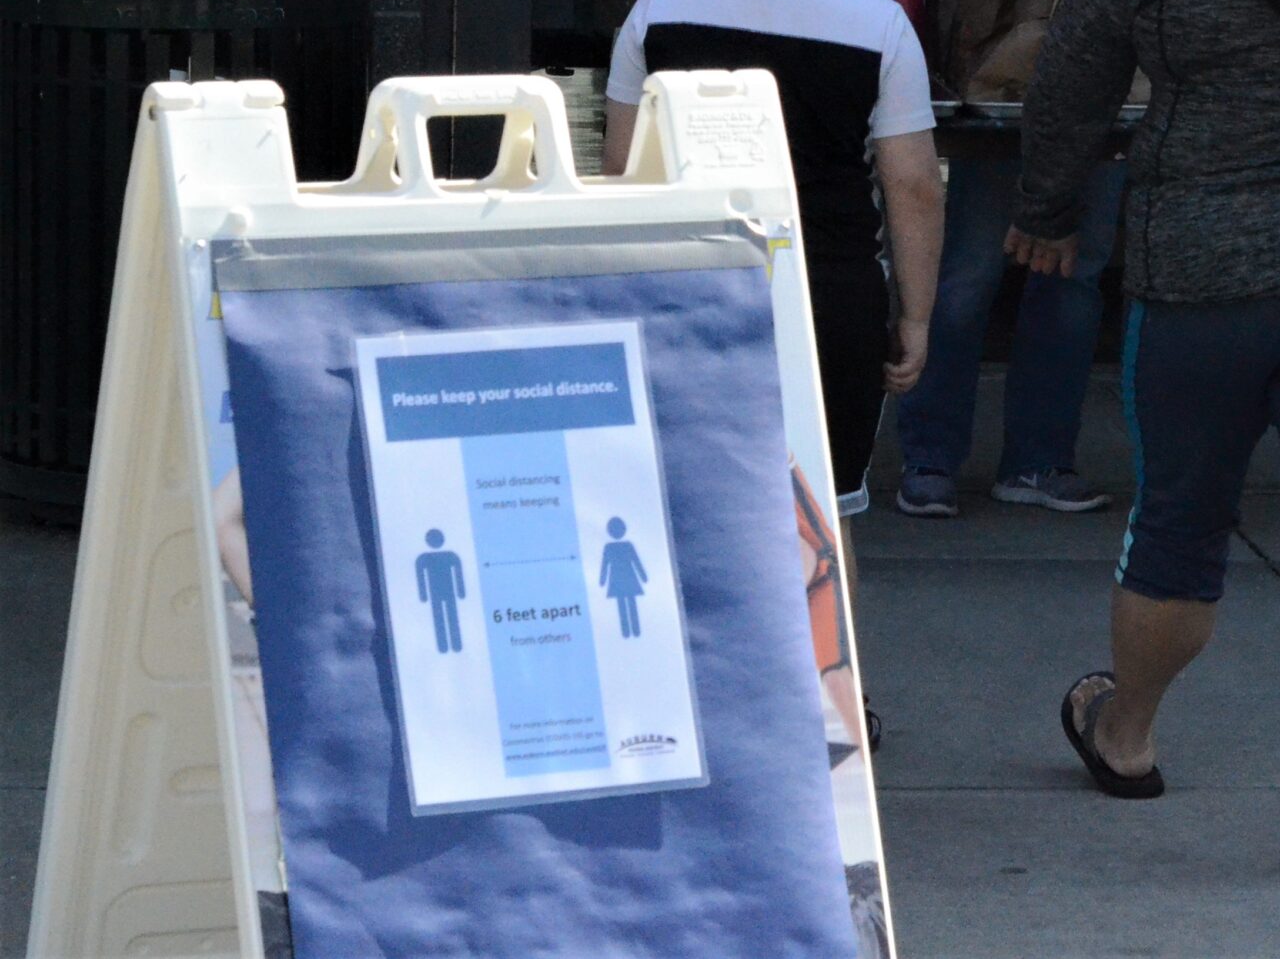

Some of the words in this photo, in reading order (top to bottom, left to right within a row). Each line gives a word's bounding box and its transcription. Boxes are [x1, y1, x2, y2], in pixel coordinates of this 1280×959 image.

[392, 392, 439, 407] Please
[440, 389, 476, 406] keep
[478, 388, 510, 404] your
[512, 382, 554, 399] social
[556, 380, 619, 397] distance.
[475, 477, 507, 490] Social
[508, 473, 561, 487] distancing
[482, 499, 517, 510] means
[519, 496, 561, 508] keeping
[492, 609, 503, 624] 6
[506, 607, 537, 622] feet
[540, 603, 582, 622] apart
[510, 635, 536, 647] from
[537, 631, 573, 645] others
